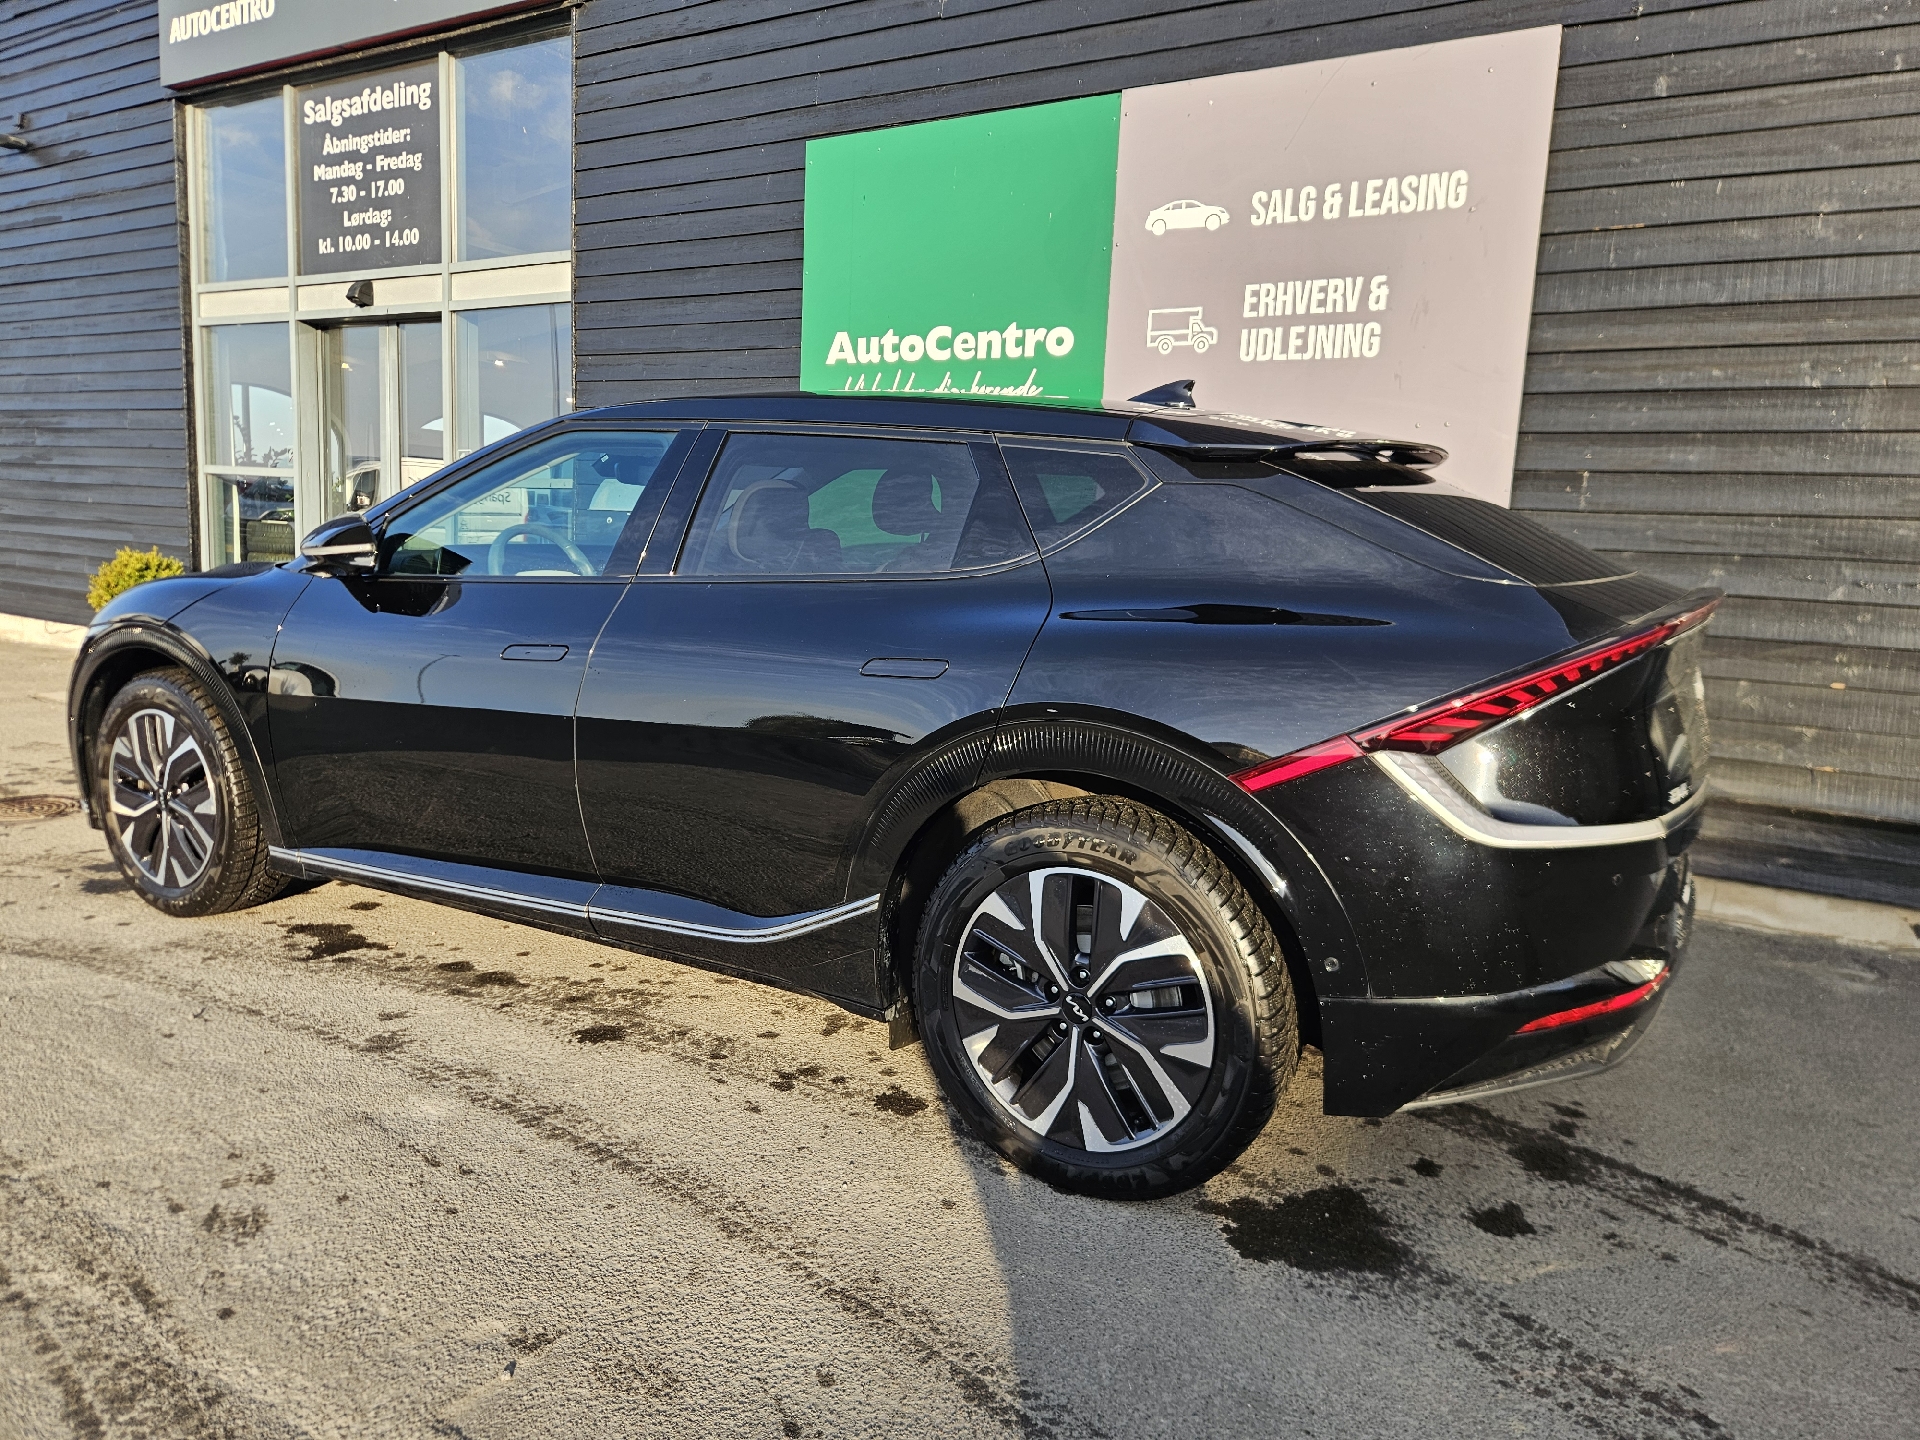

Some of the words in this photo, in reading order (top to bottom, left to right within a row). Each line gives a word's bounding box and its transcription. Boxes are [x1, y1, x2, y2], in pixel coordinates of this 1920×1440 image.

[169, 0, 276, 44] AUTOCENTRO
[304, 81, 432, 127] Salgsafdeling
[322, 127, 411, 156] Åbningstider:
[313, 160, 364, 181] Mandag
[375, 151, 423, 171] Fredag
[329, 184, 357, 204] 7.30
[371, 178, 405, 199] 17.00
[1250, 185, 1318, 227] SALG
[1322, 183, 1344, 220] &
[1348, 169, 1469, 218] LEASING
[343, 207, 392, 228] Lørdag:
[318, 237, 335, 255] kl.
[338, 233, 372, 253] 10.00
[385, 227, 420, 248] 14.00
[1243, 275, 1364, 319] ERHVERV
[1368, 274, 1390, 312] &
[825, 322, 1075, 365] AutoCentro
[1239, 321, 1382, 362] UDLEJNING
[1003, 831, 1138, 866] GOODYEAR
